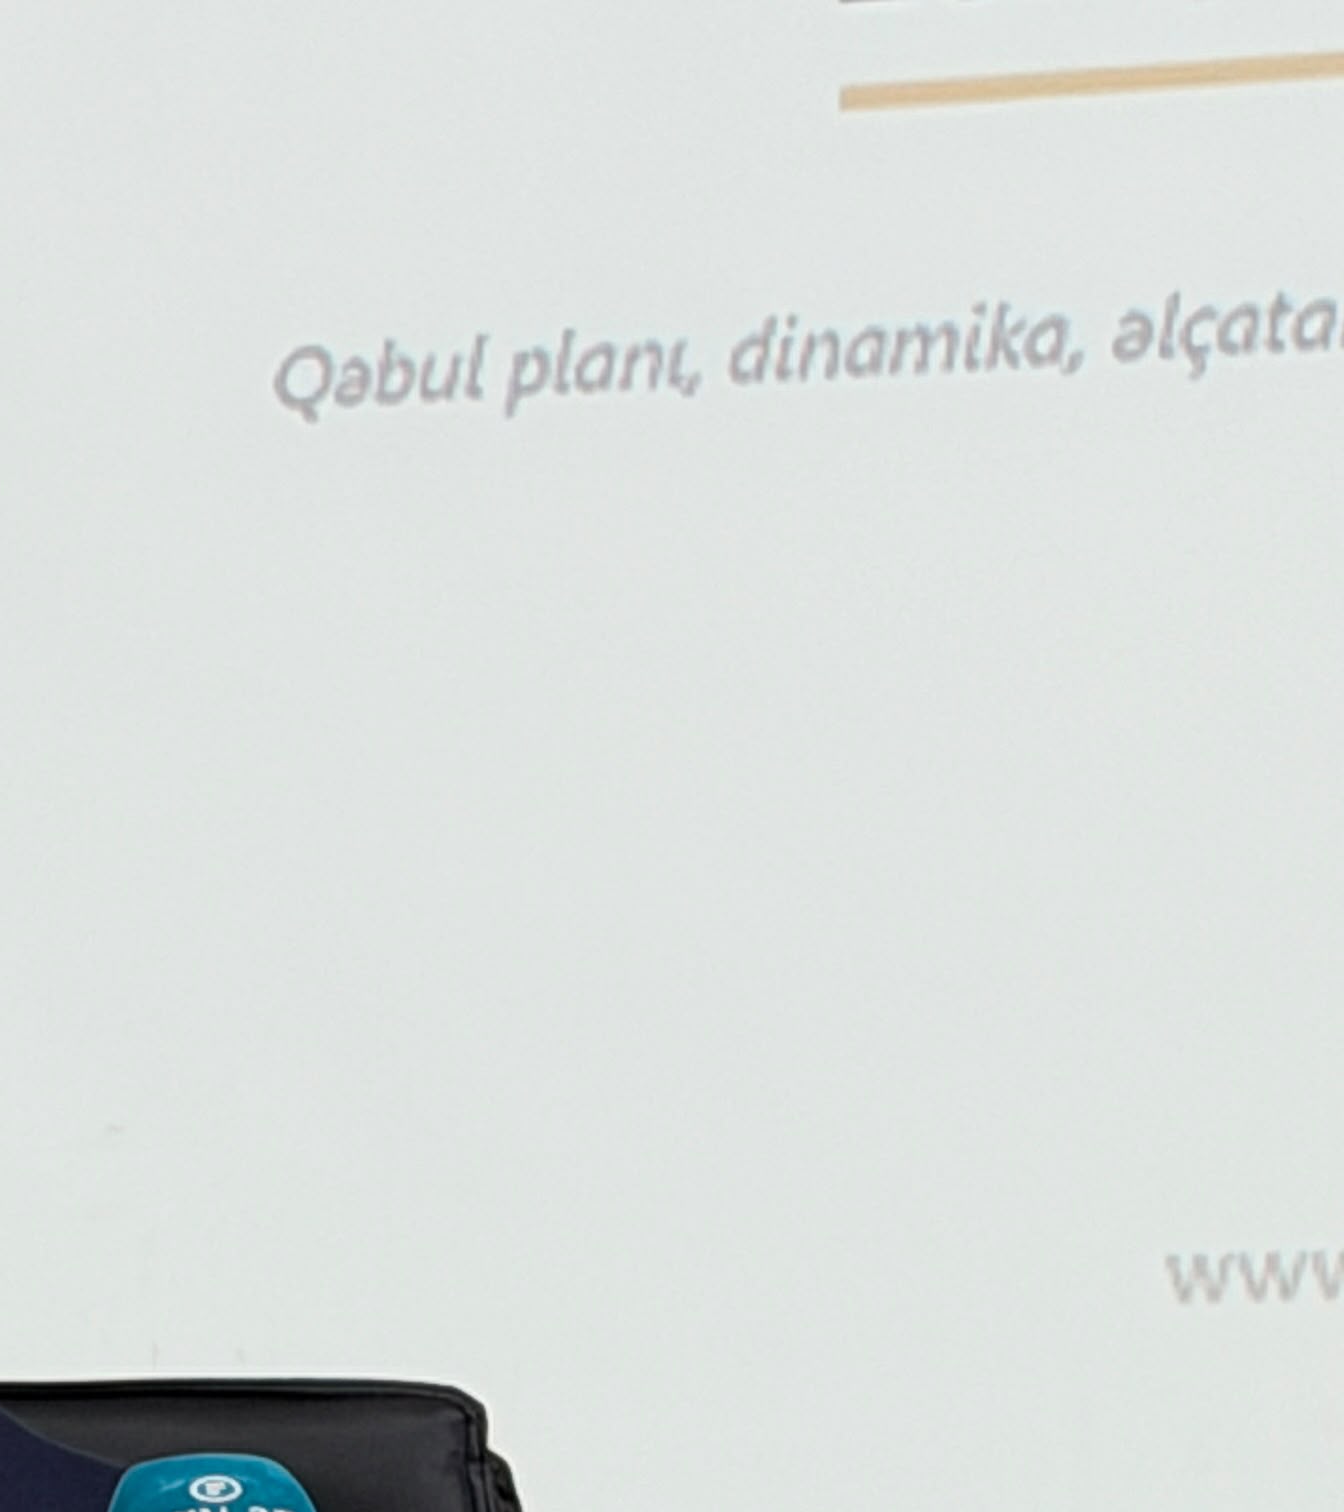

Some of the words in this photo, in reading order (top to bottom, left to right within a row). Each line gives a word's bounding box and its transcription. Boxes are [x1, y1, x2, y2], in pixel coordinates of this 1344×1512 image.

[273, 333, 490, 424] Qəbul
[727, 301, 1085, 386] dinamika,
[1110, 290, 1344, 380] əlçata
